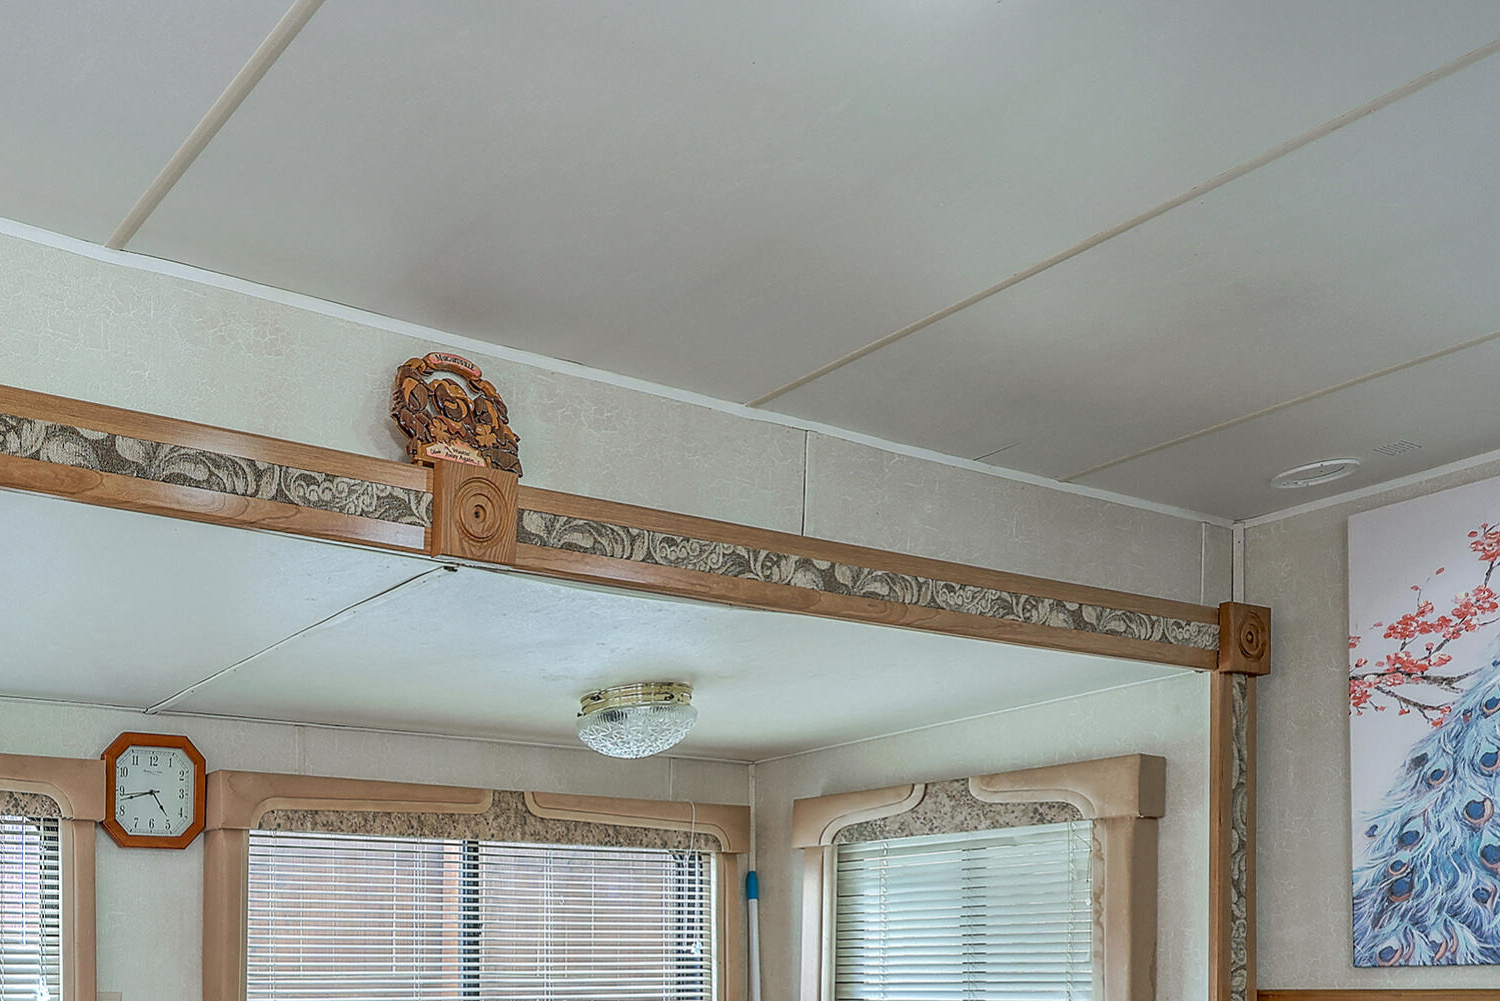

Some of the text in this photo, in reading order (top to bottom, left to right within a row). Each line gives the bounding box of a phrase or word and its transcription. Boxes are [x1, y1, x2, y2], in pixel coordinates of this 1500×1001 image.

[132, 755, 173, 768] 11 12 1
[120, 766, 129, 778] 10
[179, 770, 185, 782] 2
[119, 785, 125, 797] 9
[179, 788, 185, 800] 3
[119, 805, 125, 817] 8
[178, 807, 183, 818] 4
[133, 818, 139, 829] 7
[148, 818, 155, 830] 6
[165, 819, 171, 830] 5
